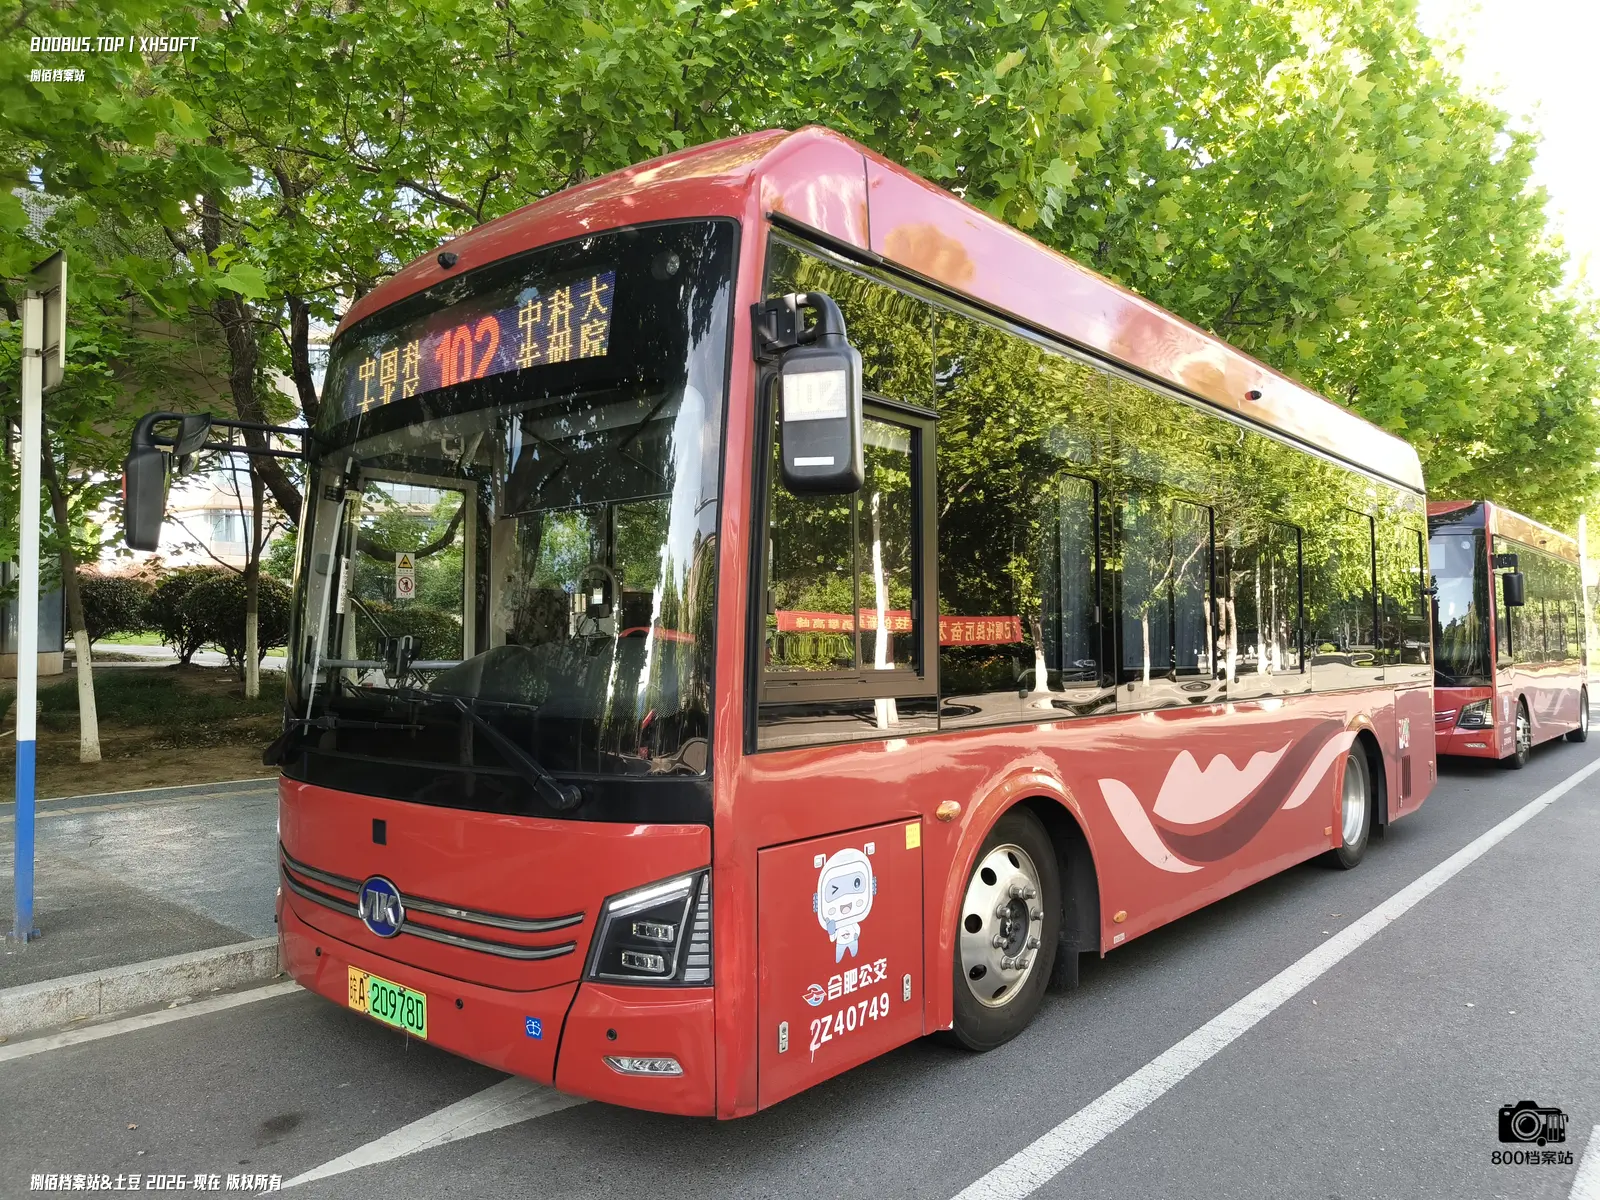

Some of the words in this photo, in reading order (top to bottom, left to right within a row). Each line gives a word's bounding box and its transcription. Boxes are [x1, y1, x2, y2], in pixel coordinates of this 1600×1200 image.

[518, 276, 608, 341] 中科大
[358, 340, 421, 394] 中国科
[435, 315, 499, 387] 102
[828, 958, 887, 1001] 合肥公交
[810, 992, 890, 1053] 2Z40749
